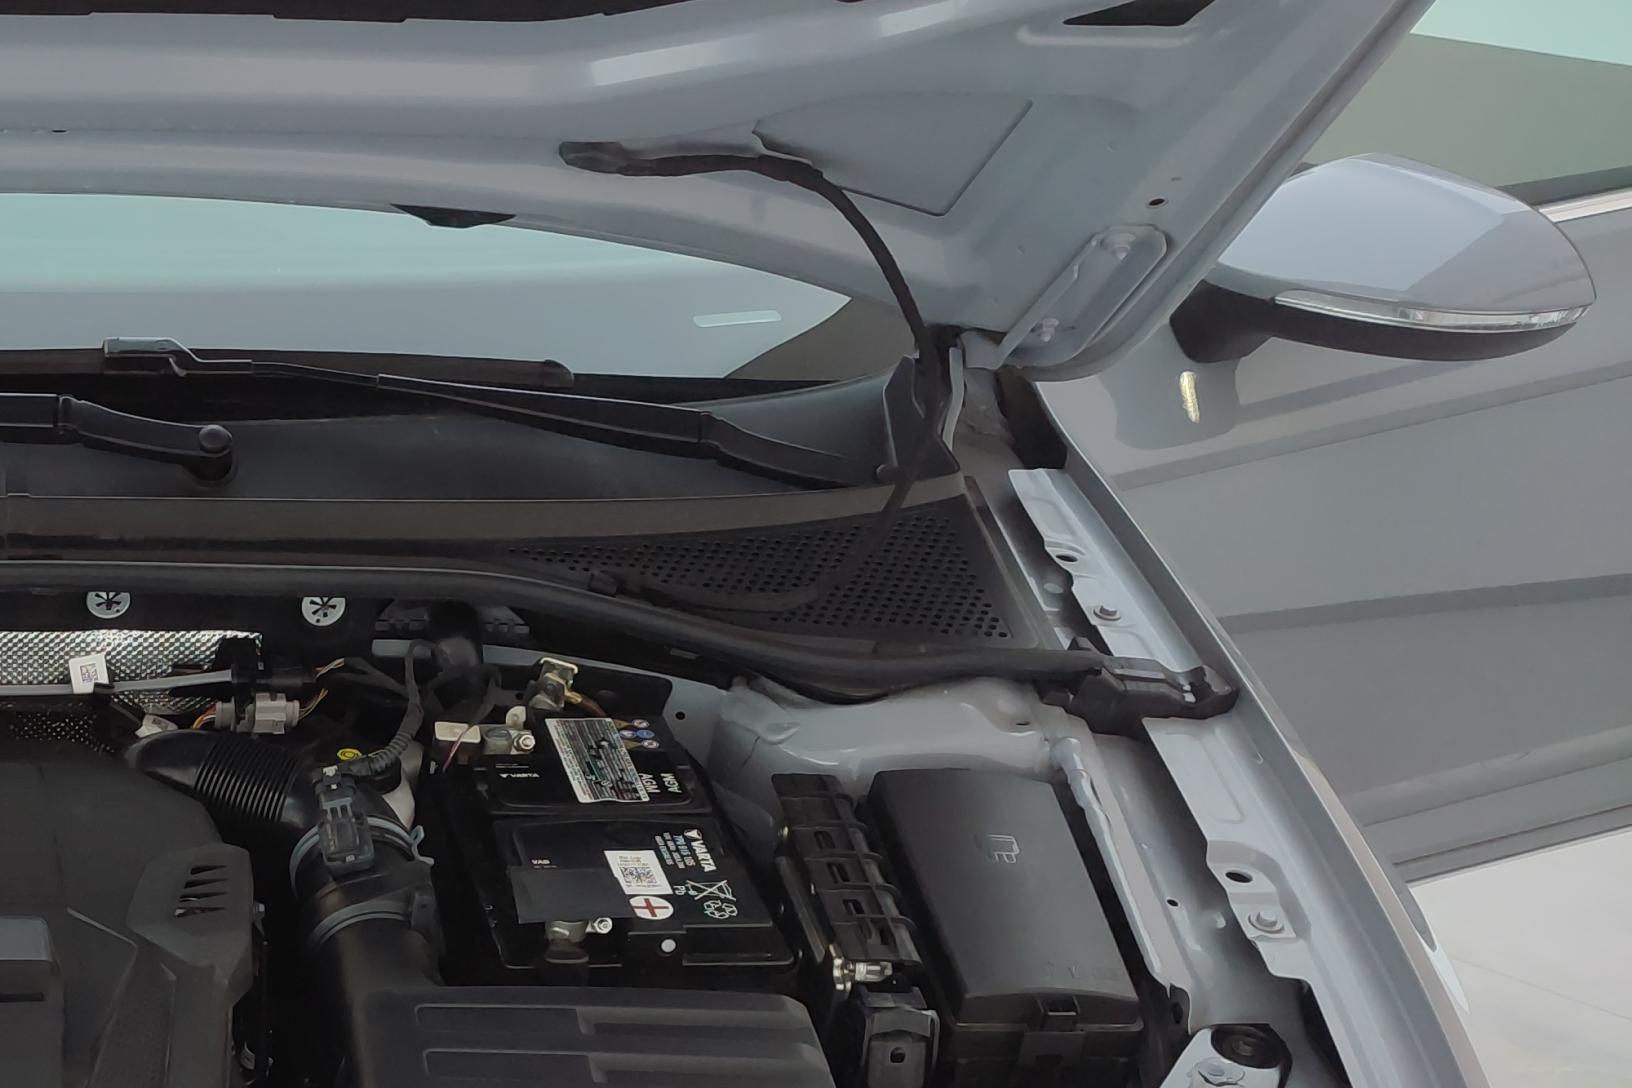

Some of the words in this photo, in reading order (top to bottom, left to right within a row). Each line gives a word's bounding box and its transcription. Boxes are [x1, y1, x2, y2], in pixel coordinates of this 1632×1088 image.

[638, 772, 661, 794] AGM
[660, 773, 682, 794] AGM
[691, 840, 717, 872] VARTA
[673, 885, 687, 896] Pb
